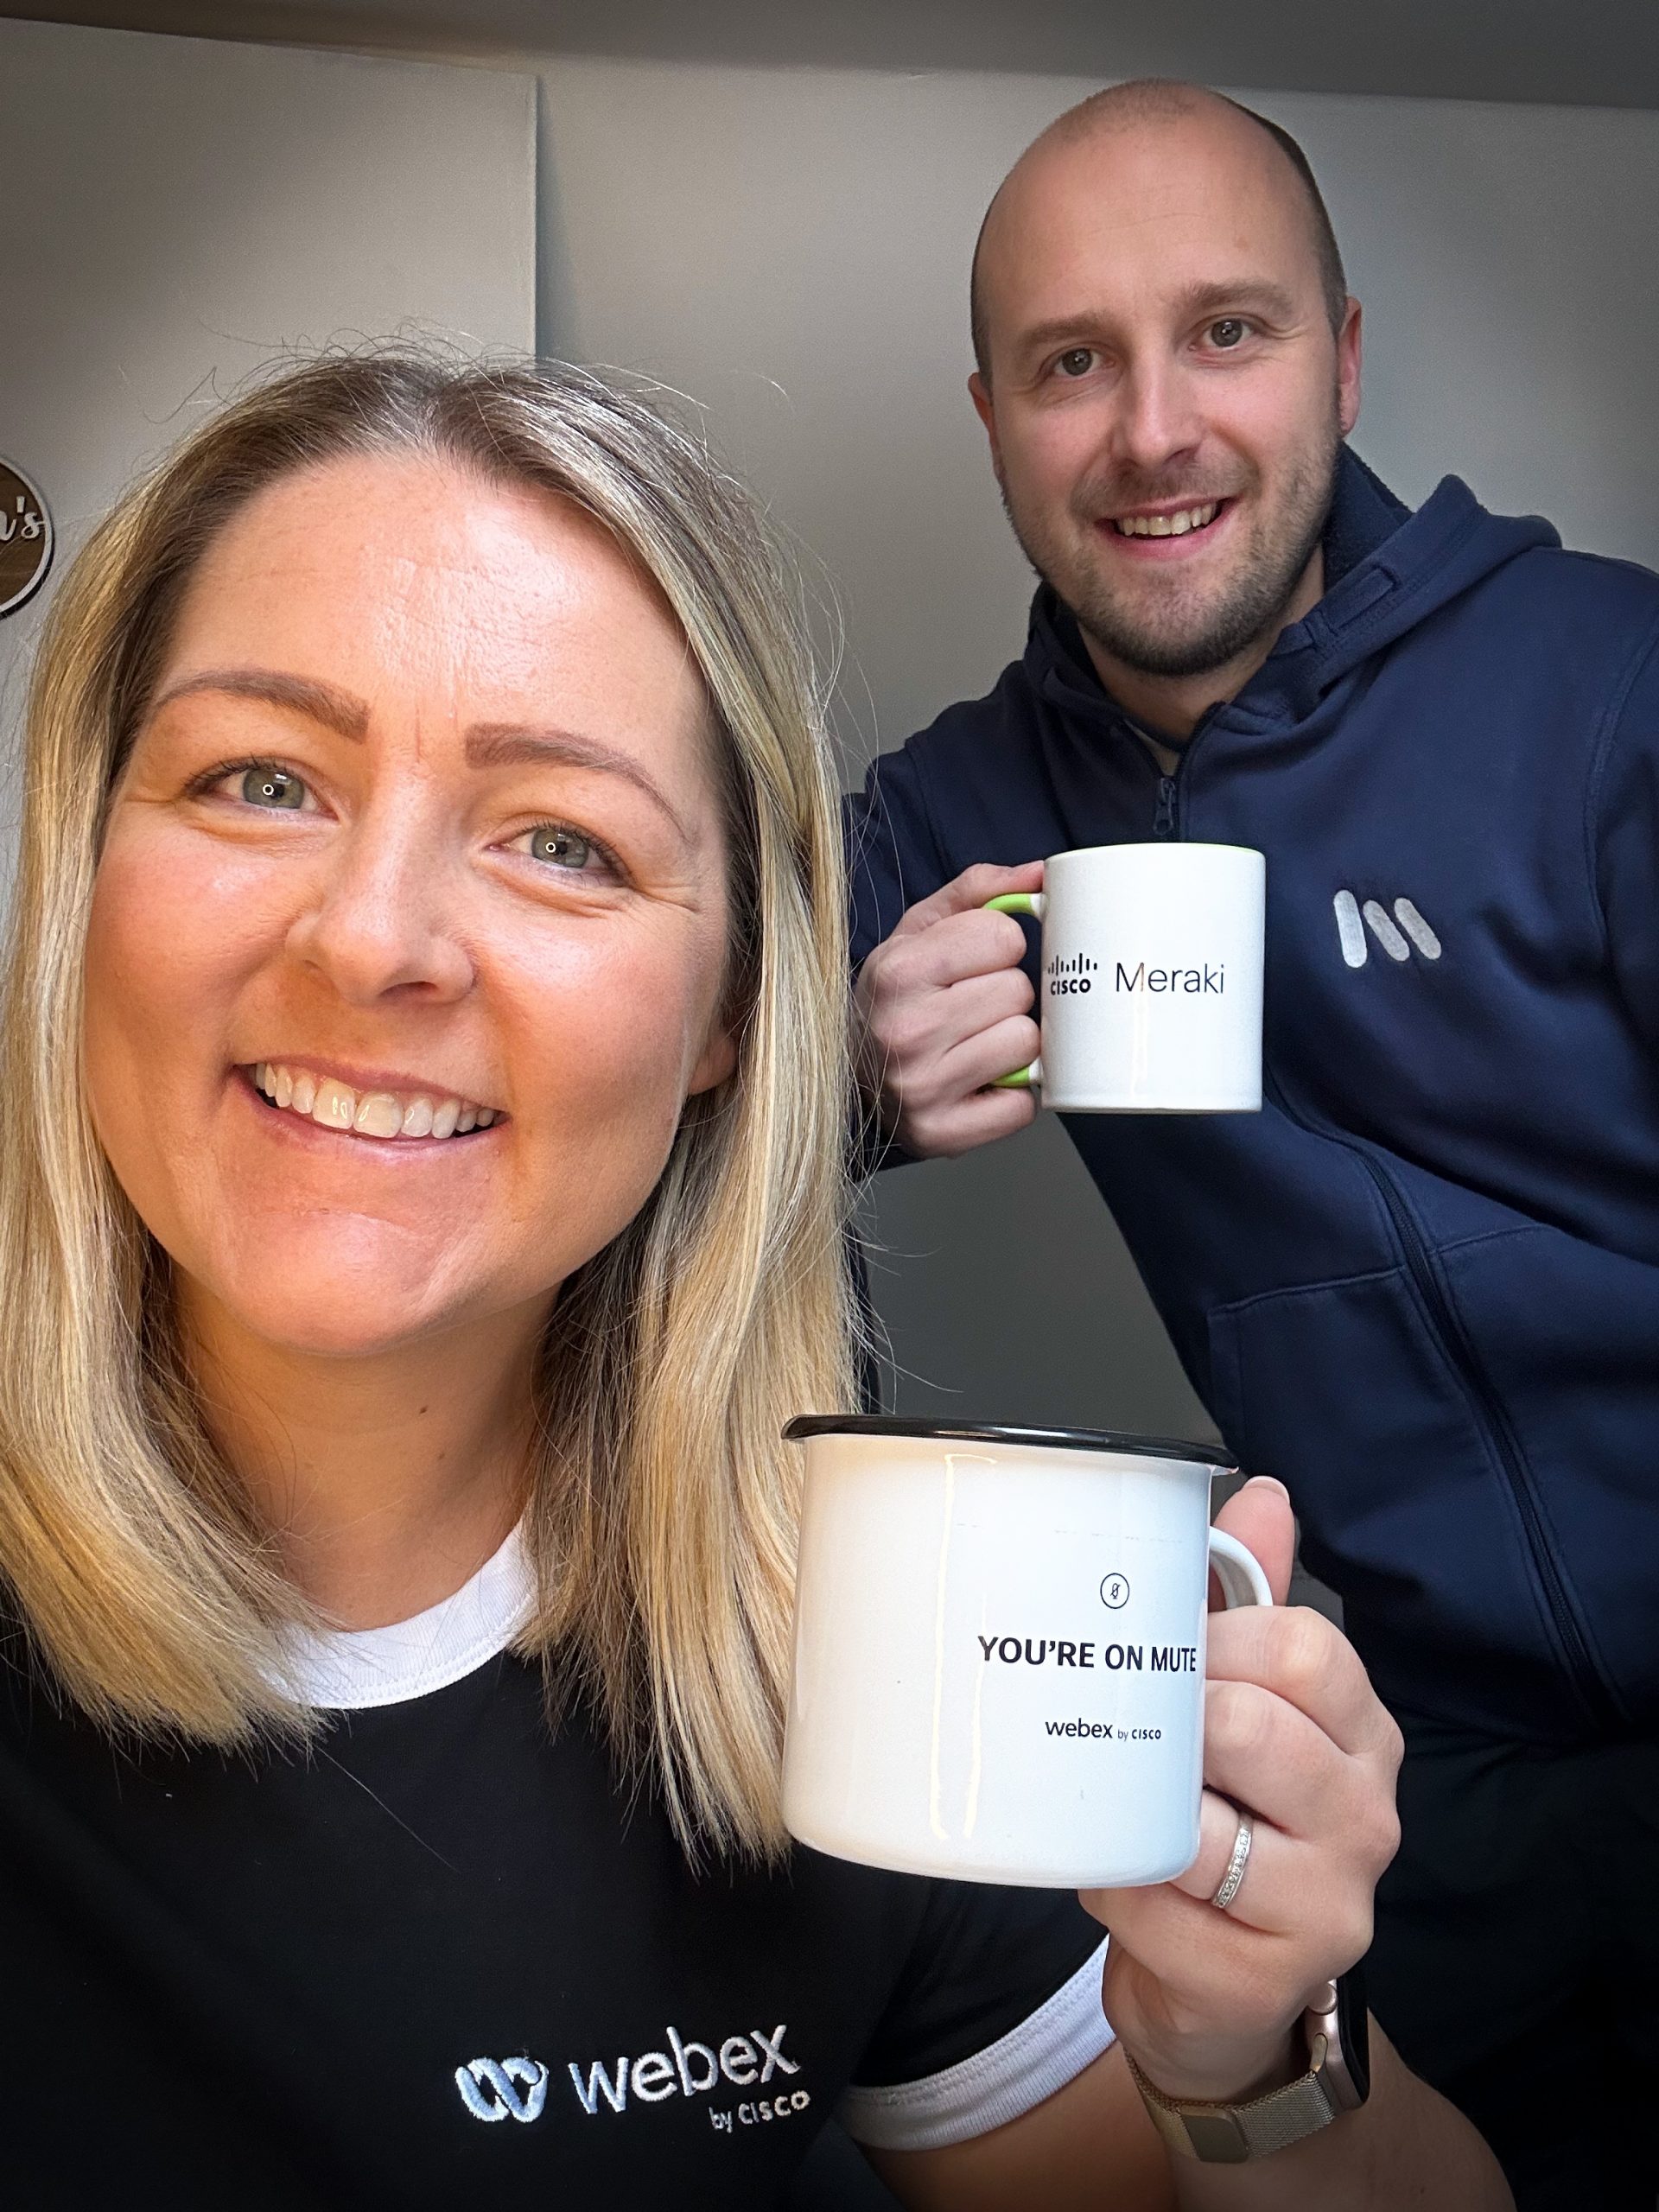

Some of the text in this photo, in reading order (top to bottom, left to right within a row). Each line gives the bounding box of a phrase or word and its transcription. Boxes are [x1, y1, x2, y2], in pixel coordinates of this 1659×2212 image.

[1050, 962, 1224, 995] CISCO Meraki
[1104, 1643, 1143, 1670] ON
[1151, 1646, 1197, 1672] MUTE
[1045, 1717, 1161, 1741] webex by CISCO
[568, 2024, 801, 2114] webex
[708, 2090, 810, 2133] by CISCO
